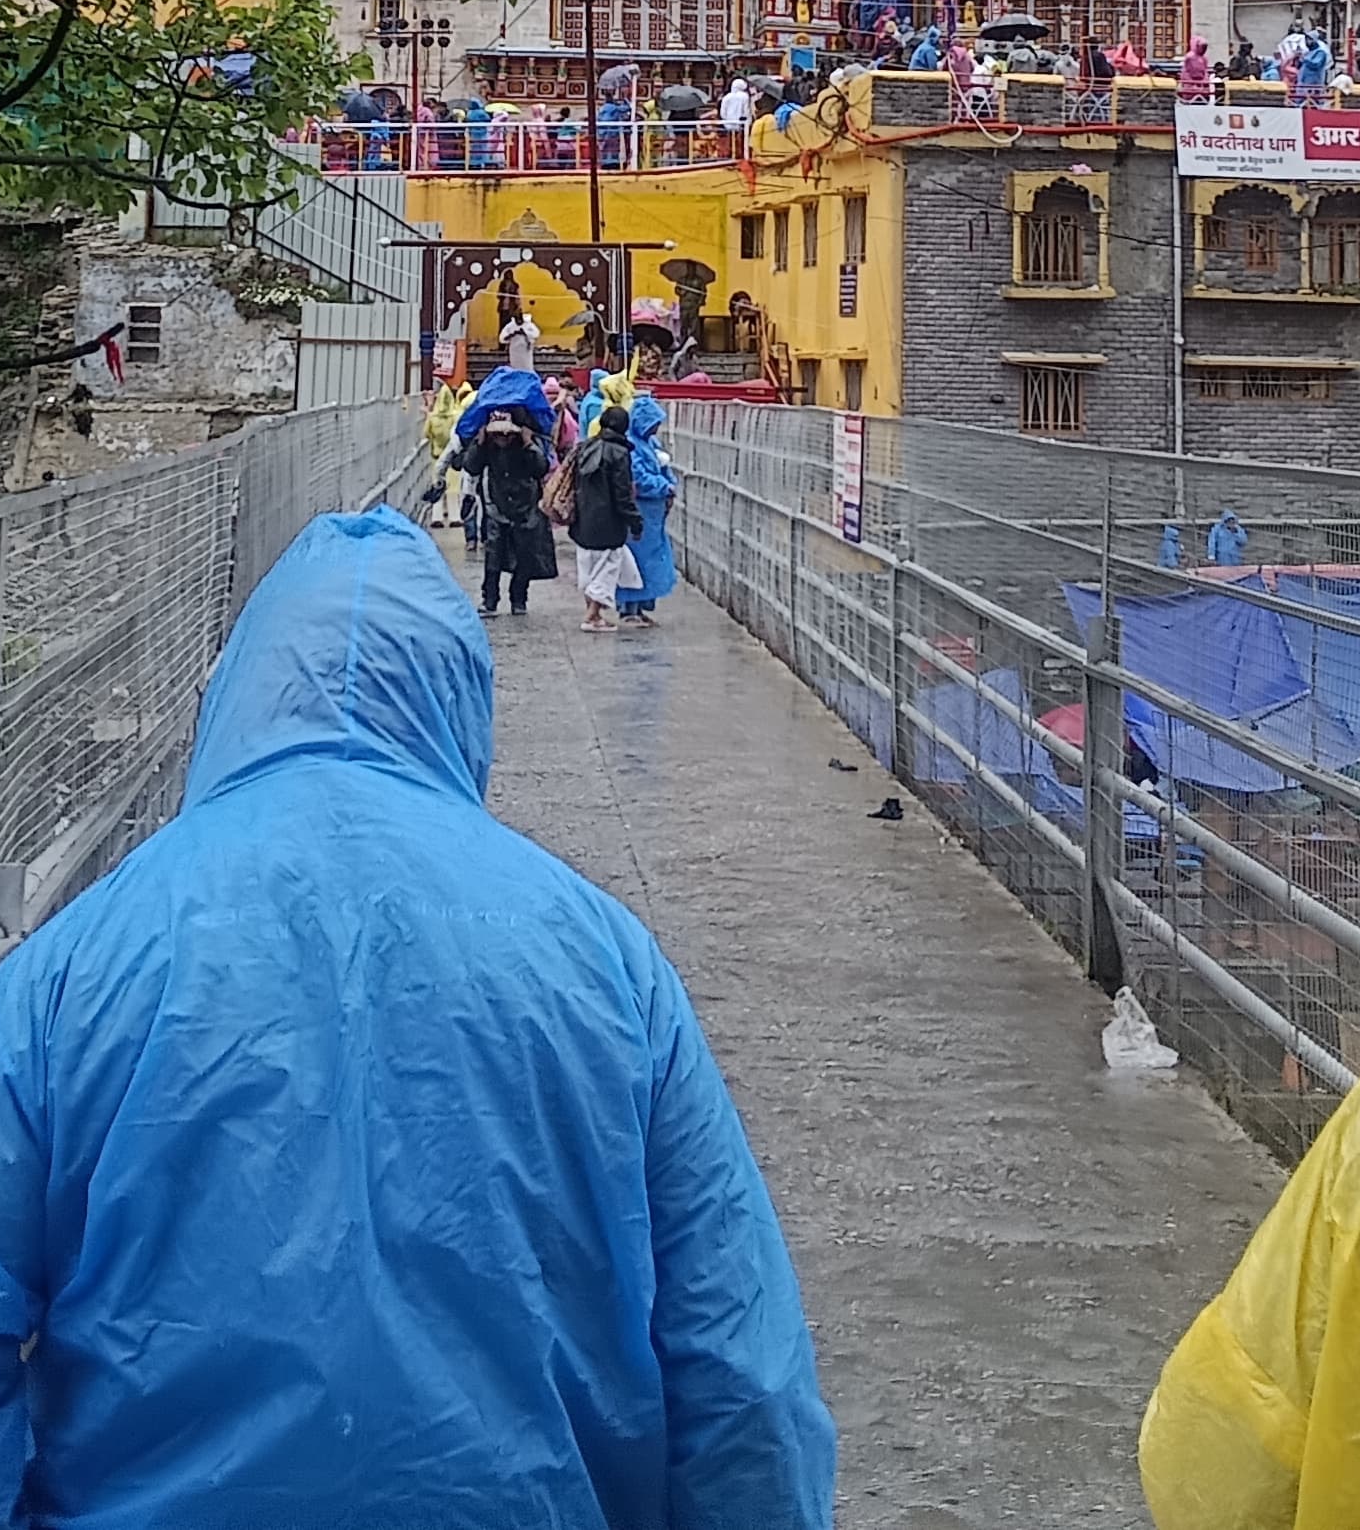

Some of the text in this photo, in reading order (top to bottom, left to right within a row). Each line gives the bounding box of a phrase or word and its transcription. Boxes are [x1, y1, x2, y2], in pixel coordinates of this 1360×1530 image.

[1179, 130, 1197, 149] श्री
[1268, 138, 1297, 152] धाम
[1309, 126, 1360, 147] अमर
